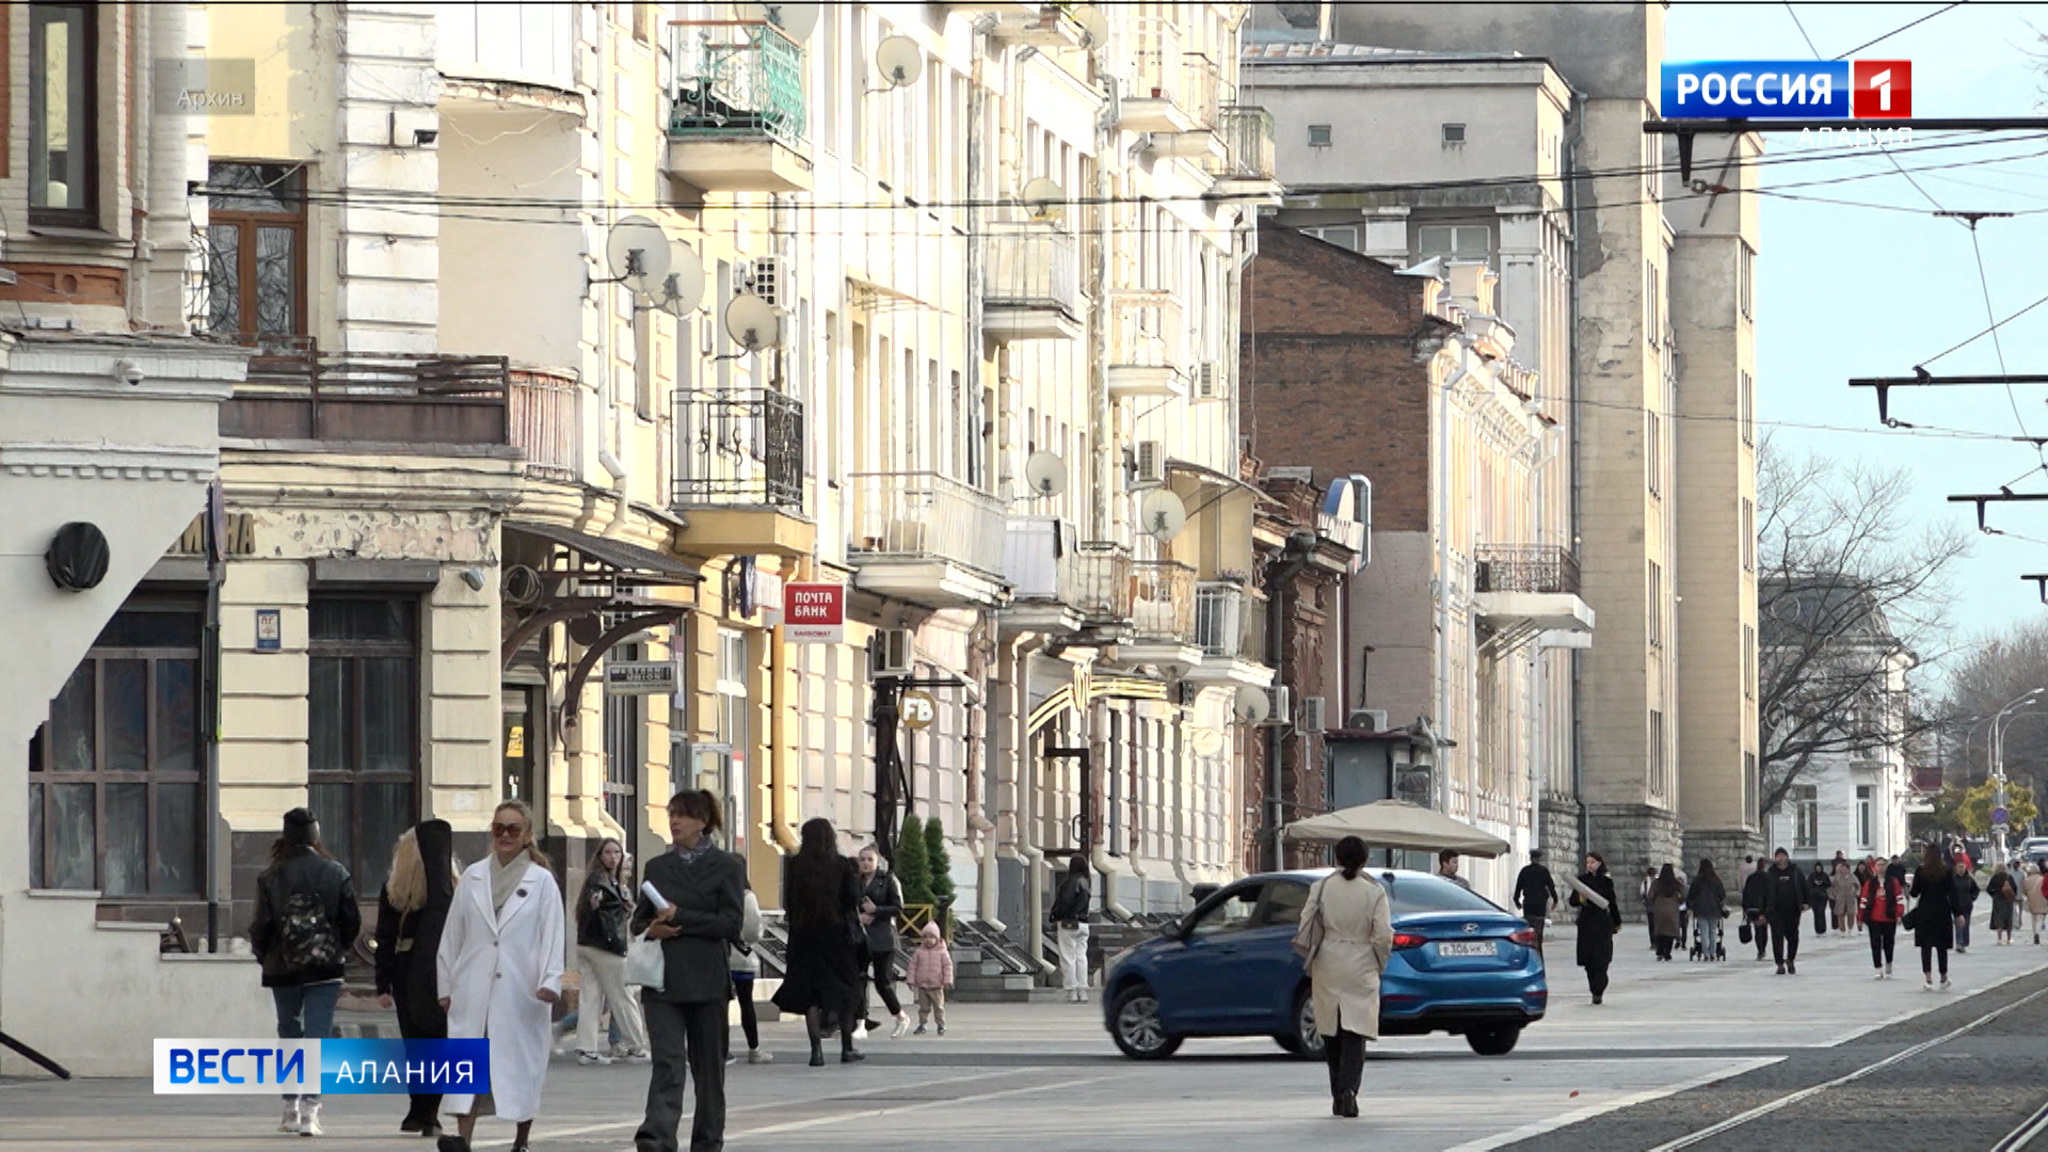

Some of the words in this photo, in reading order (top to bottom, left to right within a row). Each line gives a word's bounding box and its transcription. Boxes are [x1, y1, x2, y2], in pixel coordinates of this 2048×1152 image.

[795, 592, 833, 604] ПОЧТА
[795, 605, 827, 617] БАНК
[903, 697, 934, 722] FB
